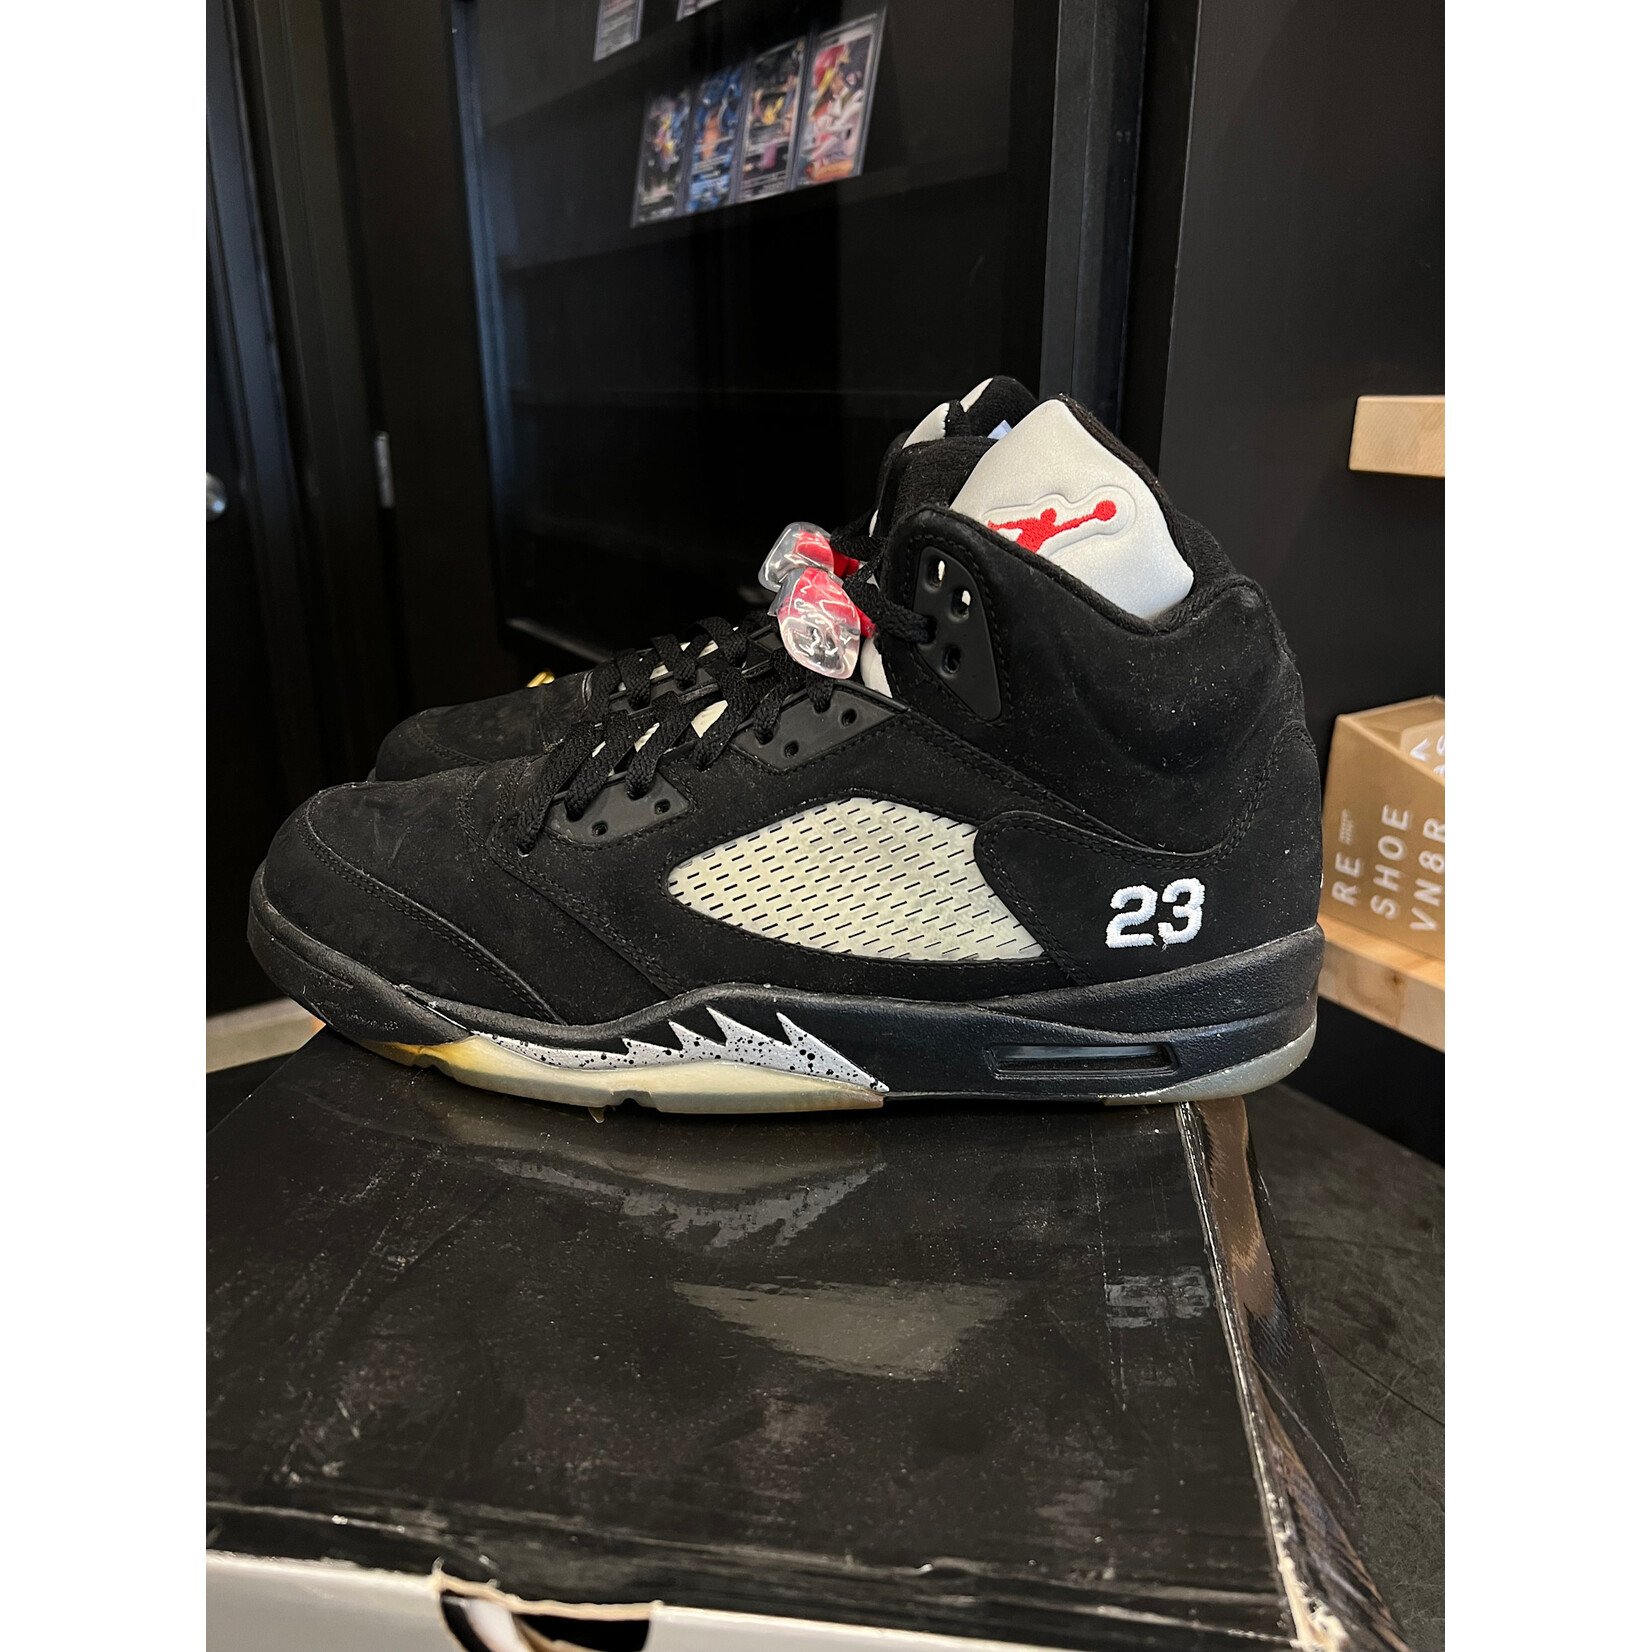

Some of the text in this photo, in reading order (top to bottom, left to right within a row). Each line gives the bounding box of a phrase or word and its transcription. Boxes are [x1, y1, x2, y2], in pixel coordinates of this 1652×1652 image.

[1331, 852, 1361, 906] RE
[1370, 804, 1410, 920] SHOE
[1105, 878, 1205, 949] 23
